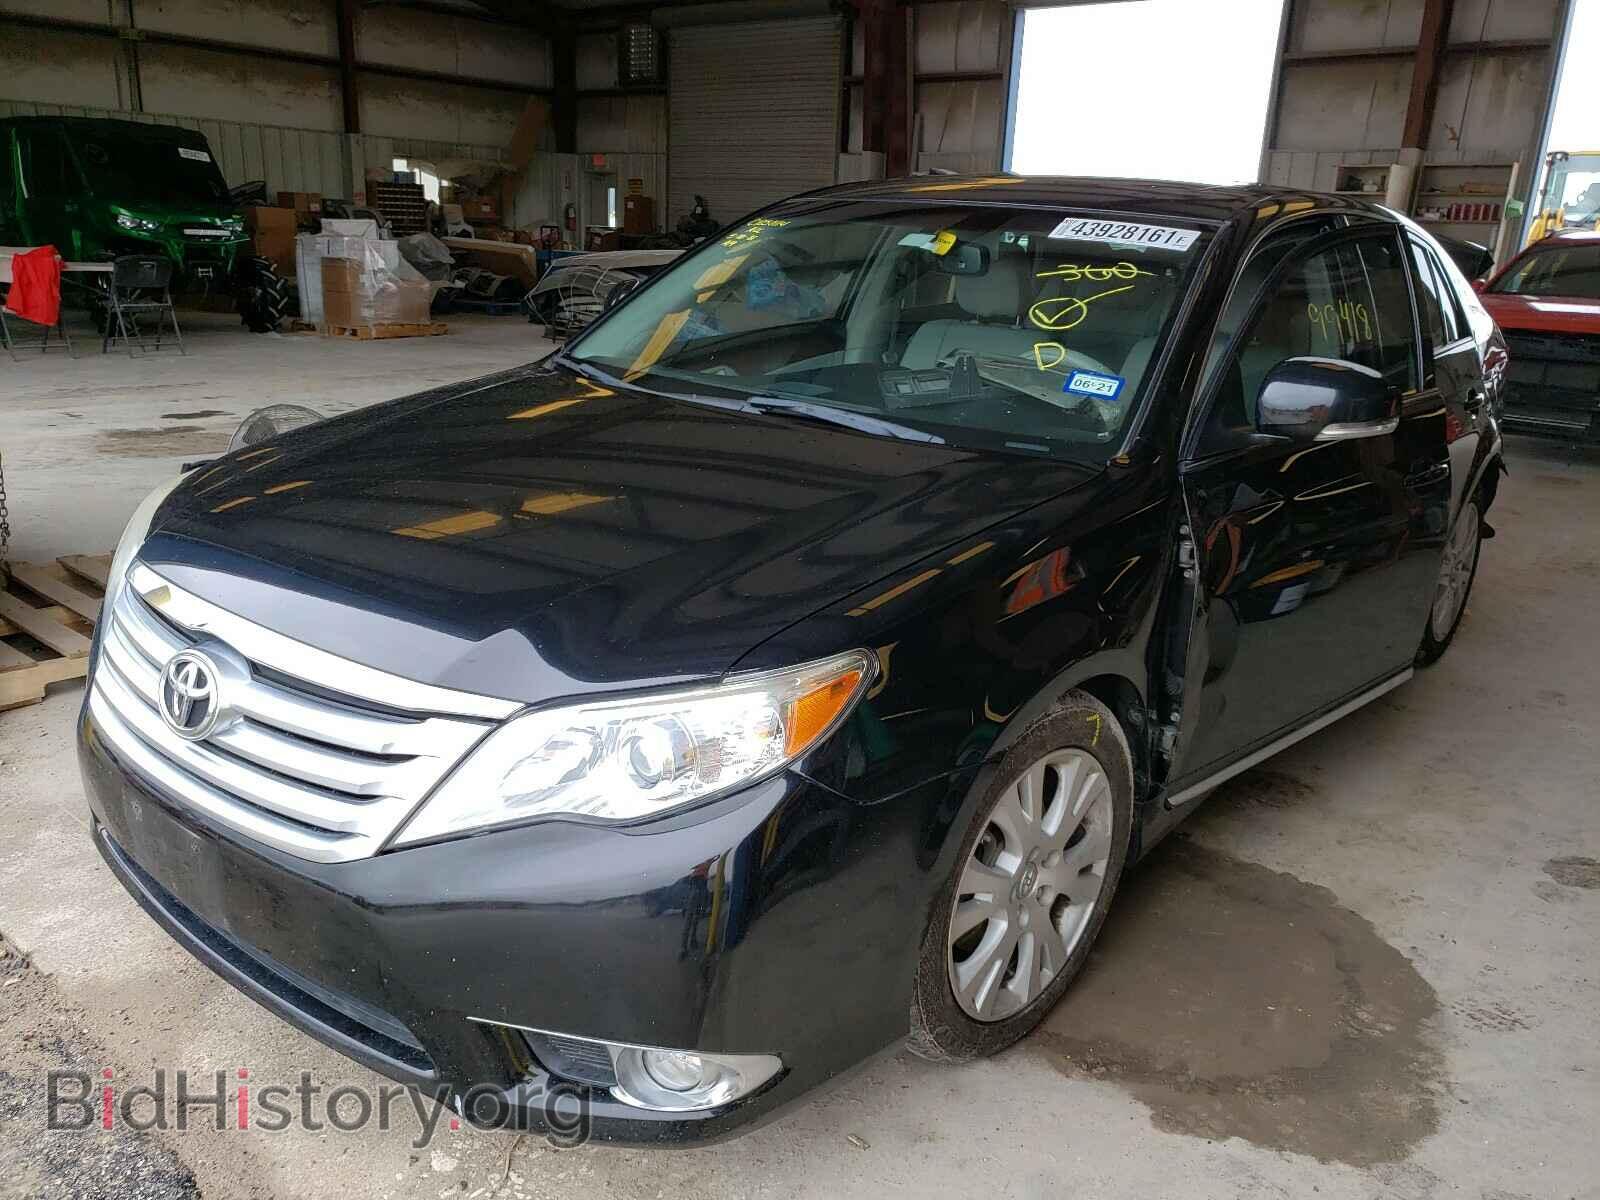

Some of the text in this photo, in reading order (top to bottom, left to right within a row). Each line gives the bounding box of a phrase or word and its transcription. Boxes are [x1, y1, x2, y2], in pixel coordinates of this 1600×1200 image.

[1070, 220, 1178, 245] 43928161
[1033, 341, 1066, 371] D
[1073, 378, 1091, 389] 06
[1095, 382, 1113, 393] 21
